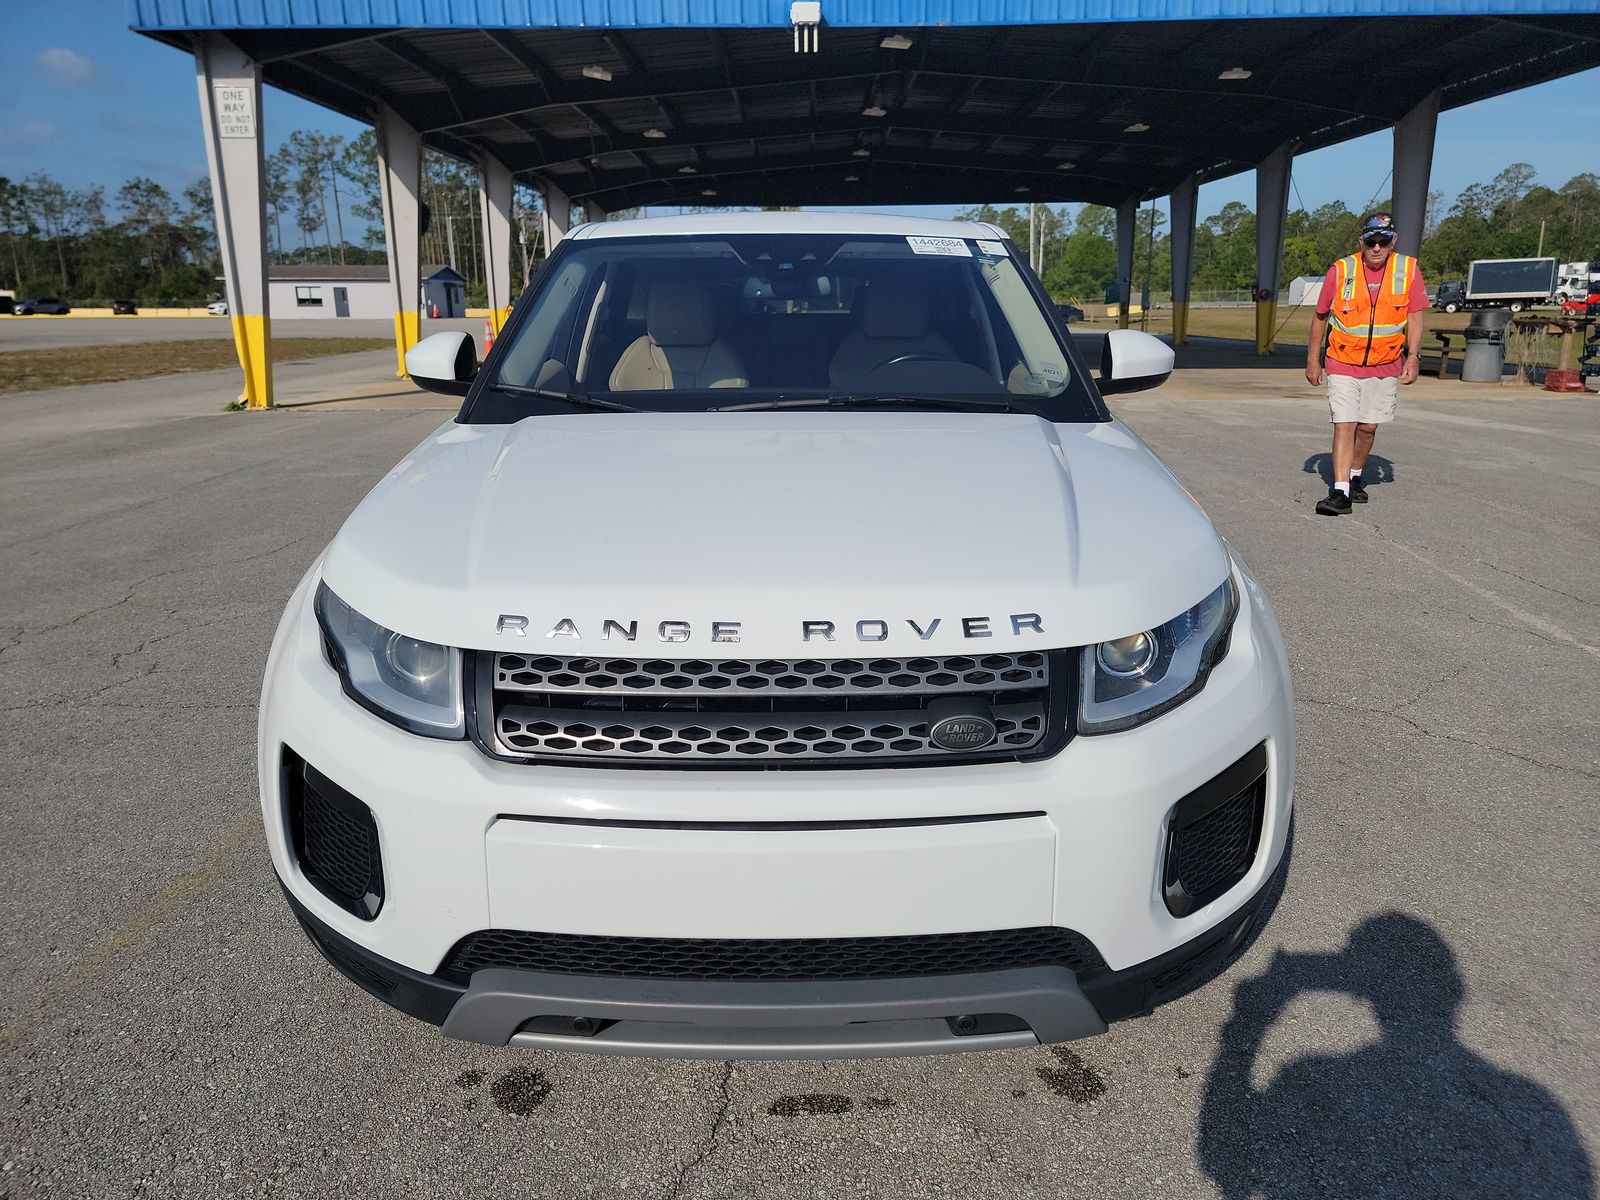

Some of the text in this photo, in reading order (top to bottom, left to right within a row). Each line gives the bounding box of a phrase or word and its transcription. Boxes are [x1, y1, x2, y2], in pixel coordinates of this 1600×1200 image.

[222, 91, 244, 100] ONE
[224, 104, 245, 112] WAY
[220, 115, 250, 124] DO NOT
[224, 126, 249, 134] ENTER
[911, 238, 963, 248] 1442684
[495, 612, 1046, 643] RANGE ROVER
[946, 724, 976, 734] LAND
[948, 732, 984, 742] ROVER
